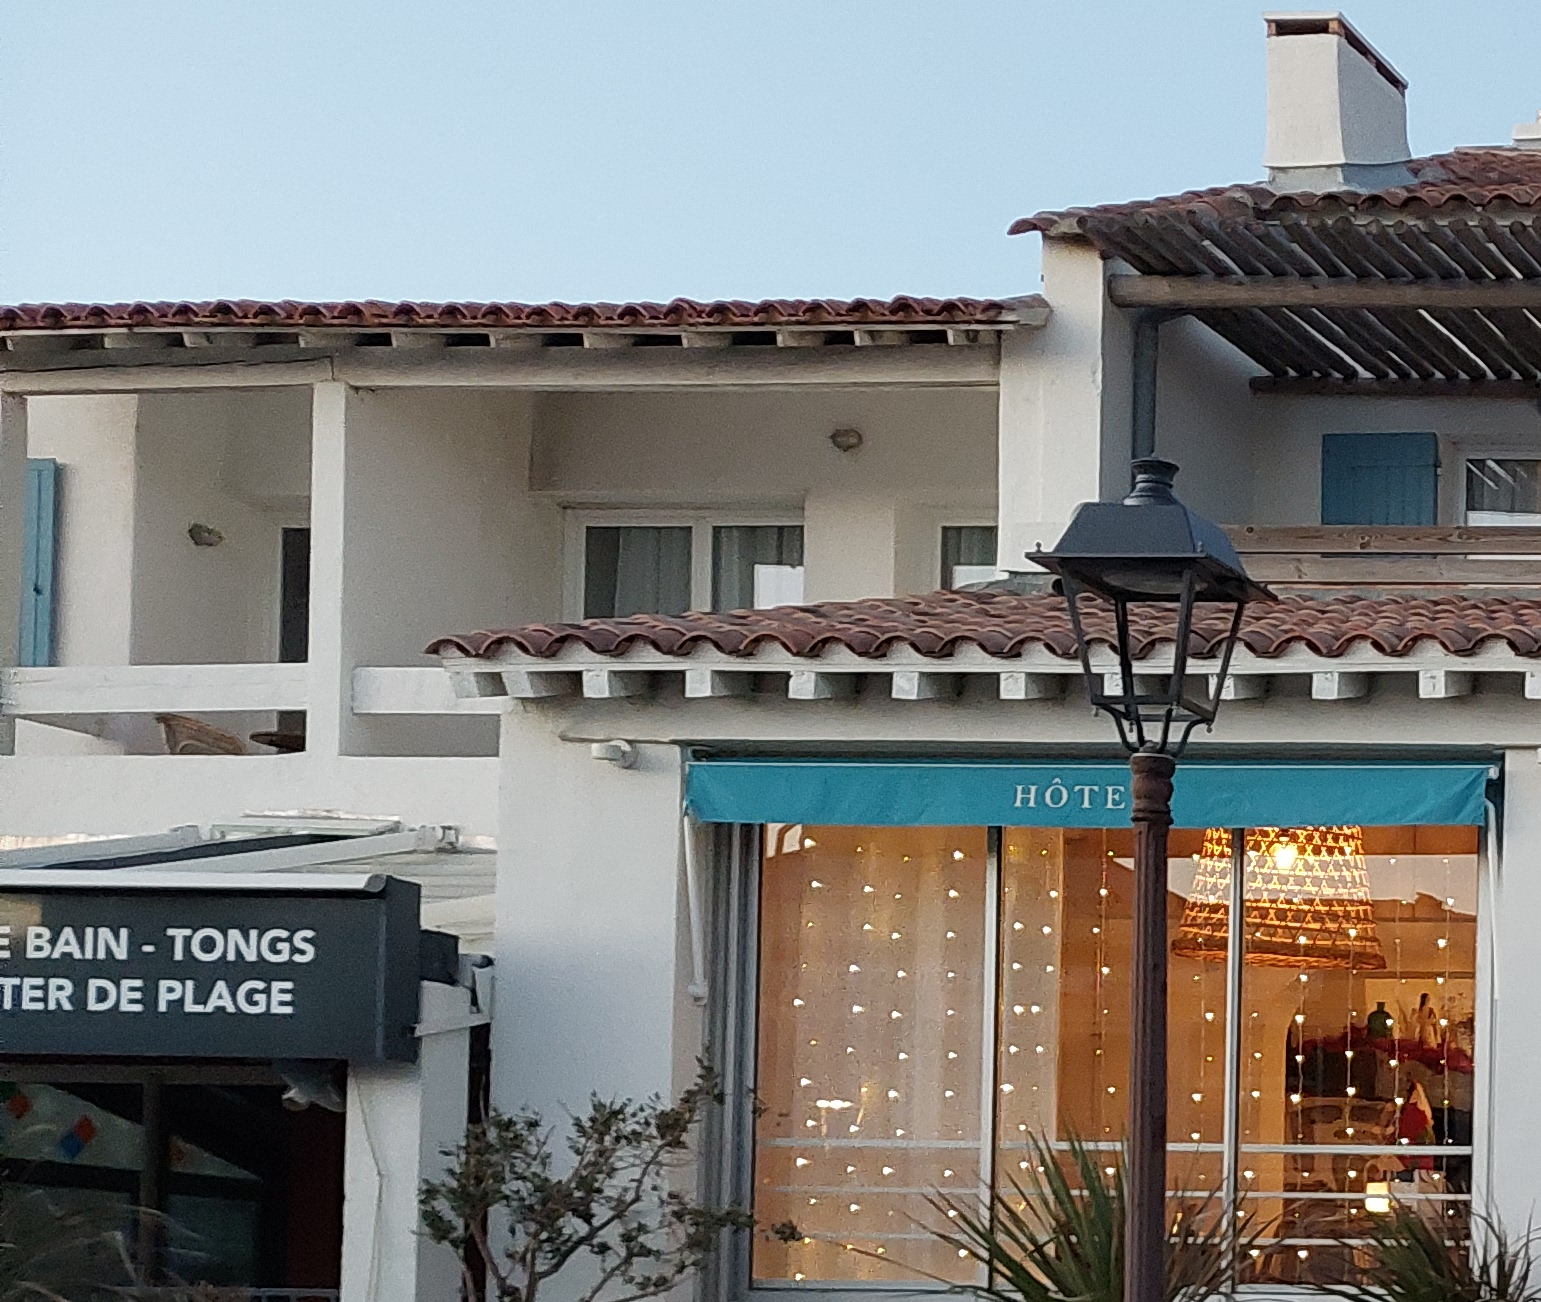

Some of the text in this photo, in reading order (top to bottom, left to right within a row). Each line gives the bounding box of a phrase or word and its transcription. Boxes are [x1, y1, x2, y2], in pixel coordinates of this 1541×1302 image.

[1012, 777, 1128, 810] HÔTE
[25, 925, 128, 960] BAIN
[166, 927, 316, 963] TONGS
[86, 977, 144, 1012] DE
[157, 979, 295, 1014] PLAGE
